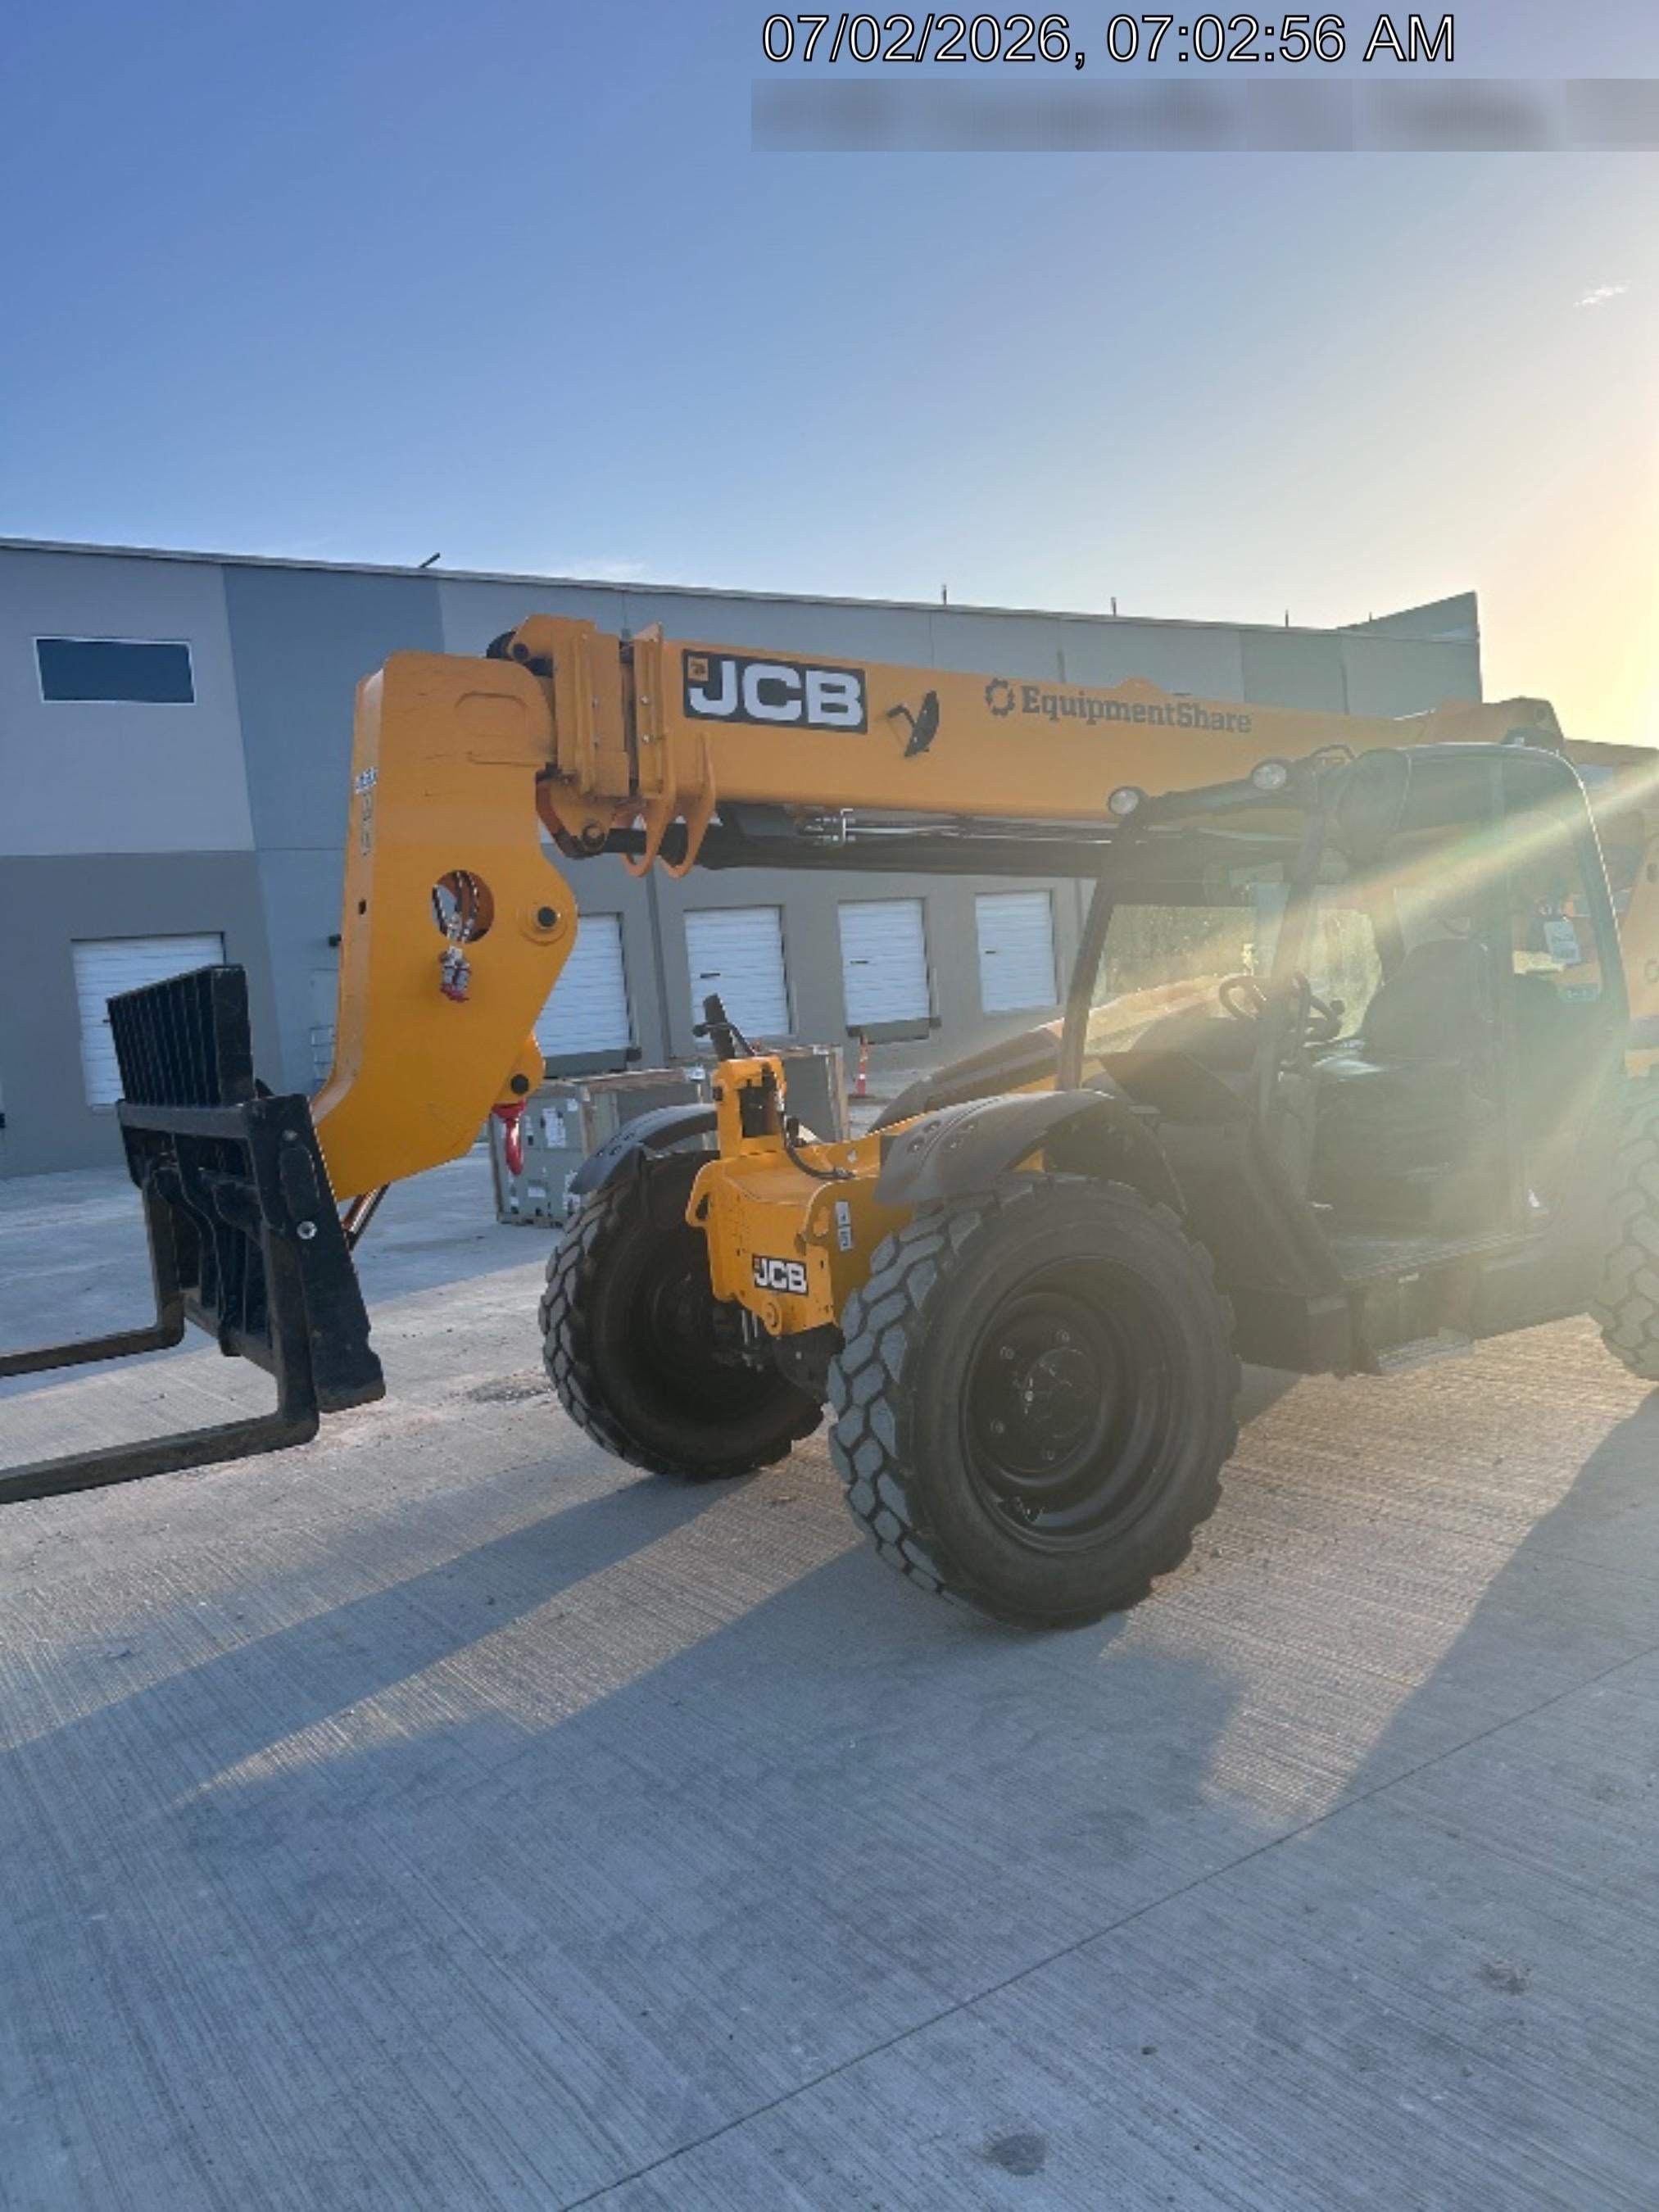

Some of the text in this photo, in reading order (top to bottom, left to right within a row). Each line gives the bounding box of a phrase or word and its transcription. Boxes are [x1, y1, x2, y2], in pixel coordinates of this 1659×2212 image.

[688, 659, 863, 726] JCB
[1022, 686, 1253, 734] EquipmentShare
[755, 1258, 807, 1294] JCB
